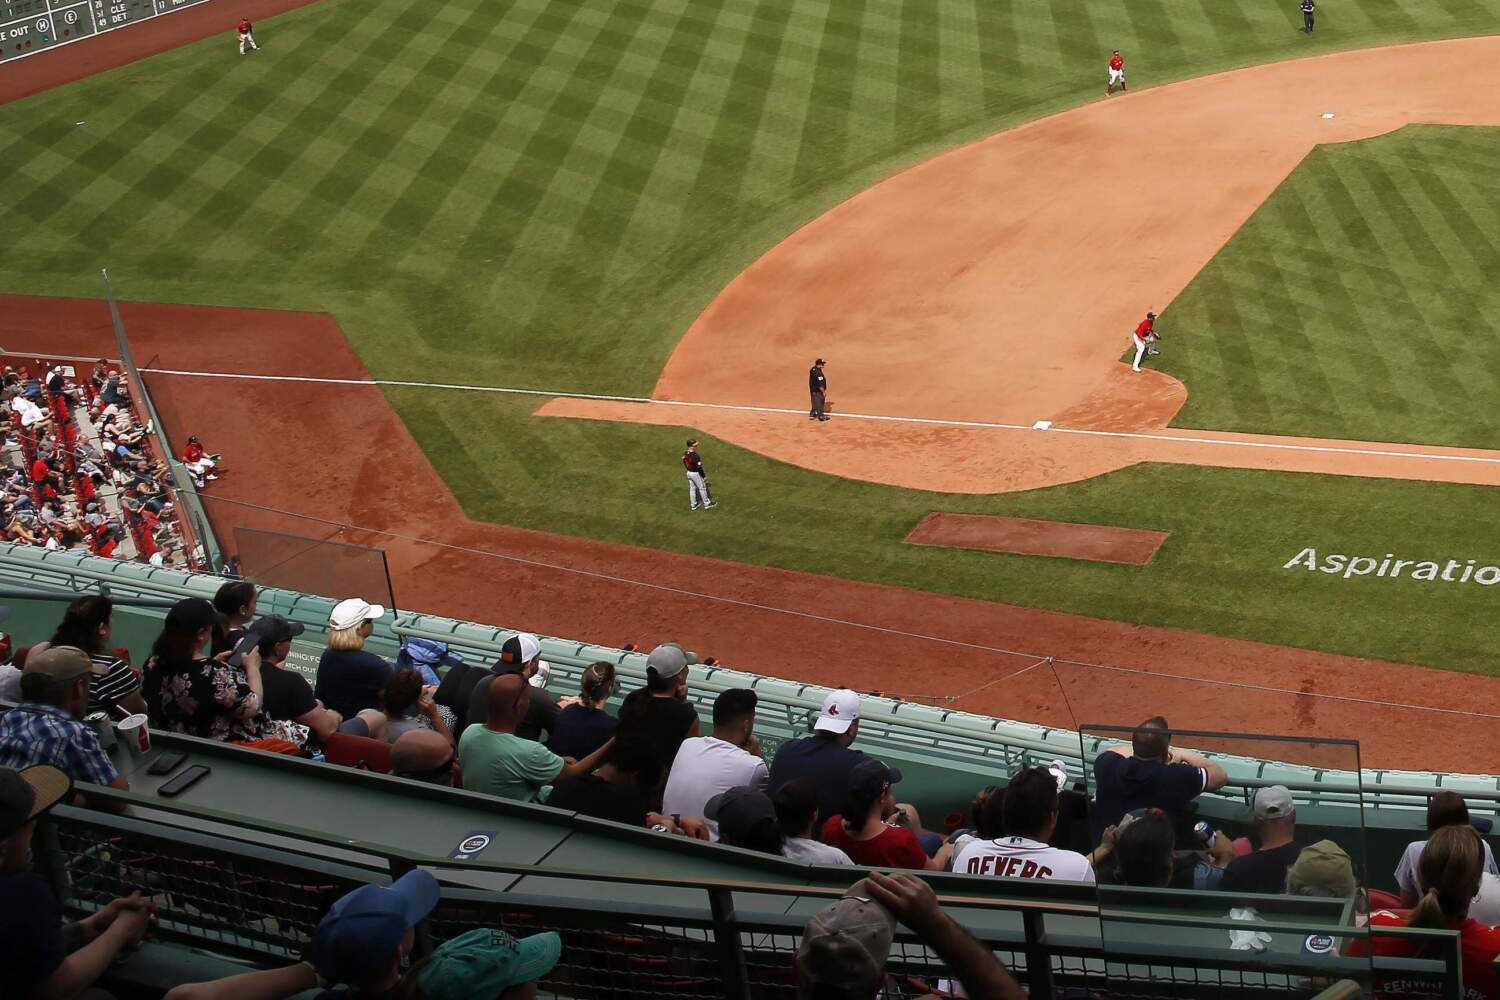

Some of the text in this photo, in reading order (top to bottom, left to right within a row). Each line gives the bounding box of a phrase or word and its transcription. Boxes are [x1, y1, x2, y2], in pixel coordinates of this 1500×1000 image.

[110, 3, 127, 14] CLE
[112, 13, 128, 23] DET
[9, 25, 29, 38] OUT
[302, 666, 317, 674] OUT
